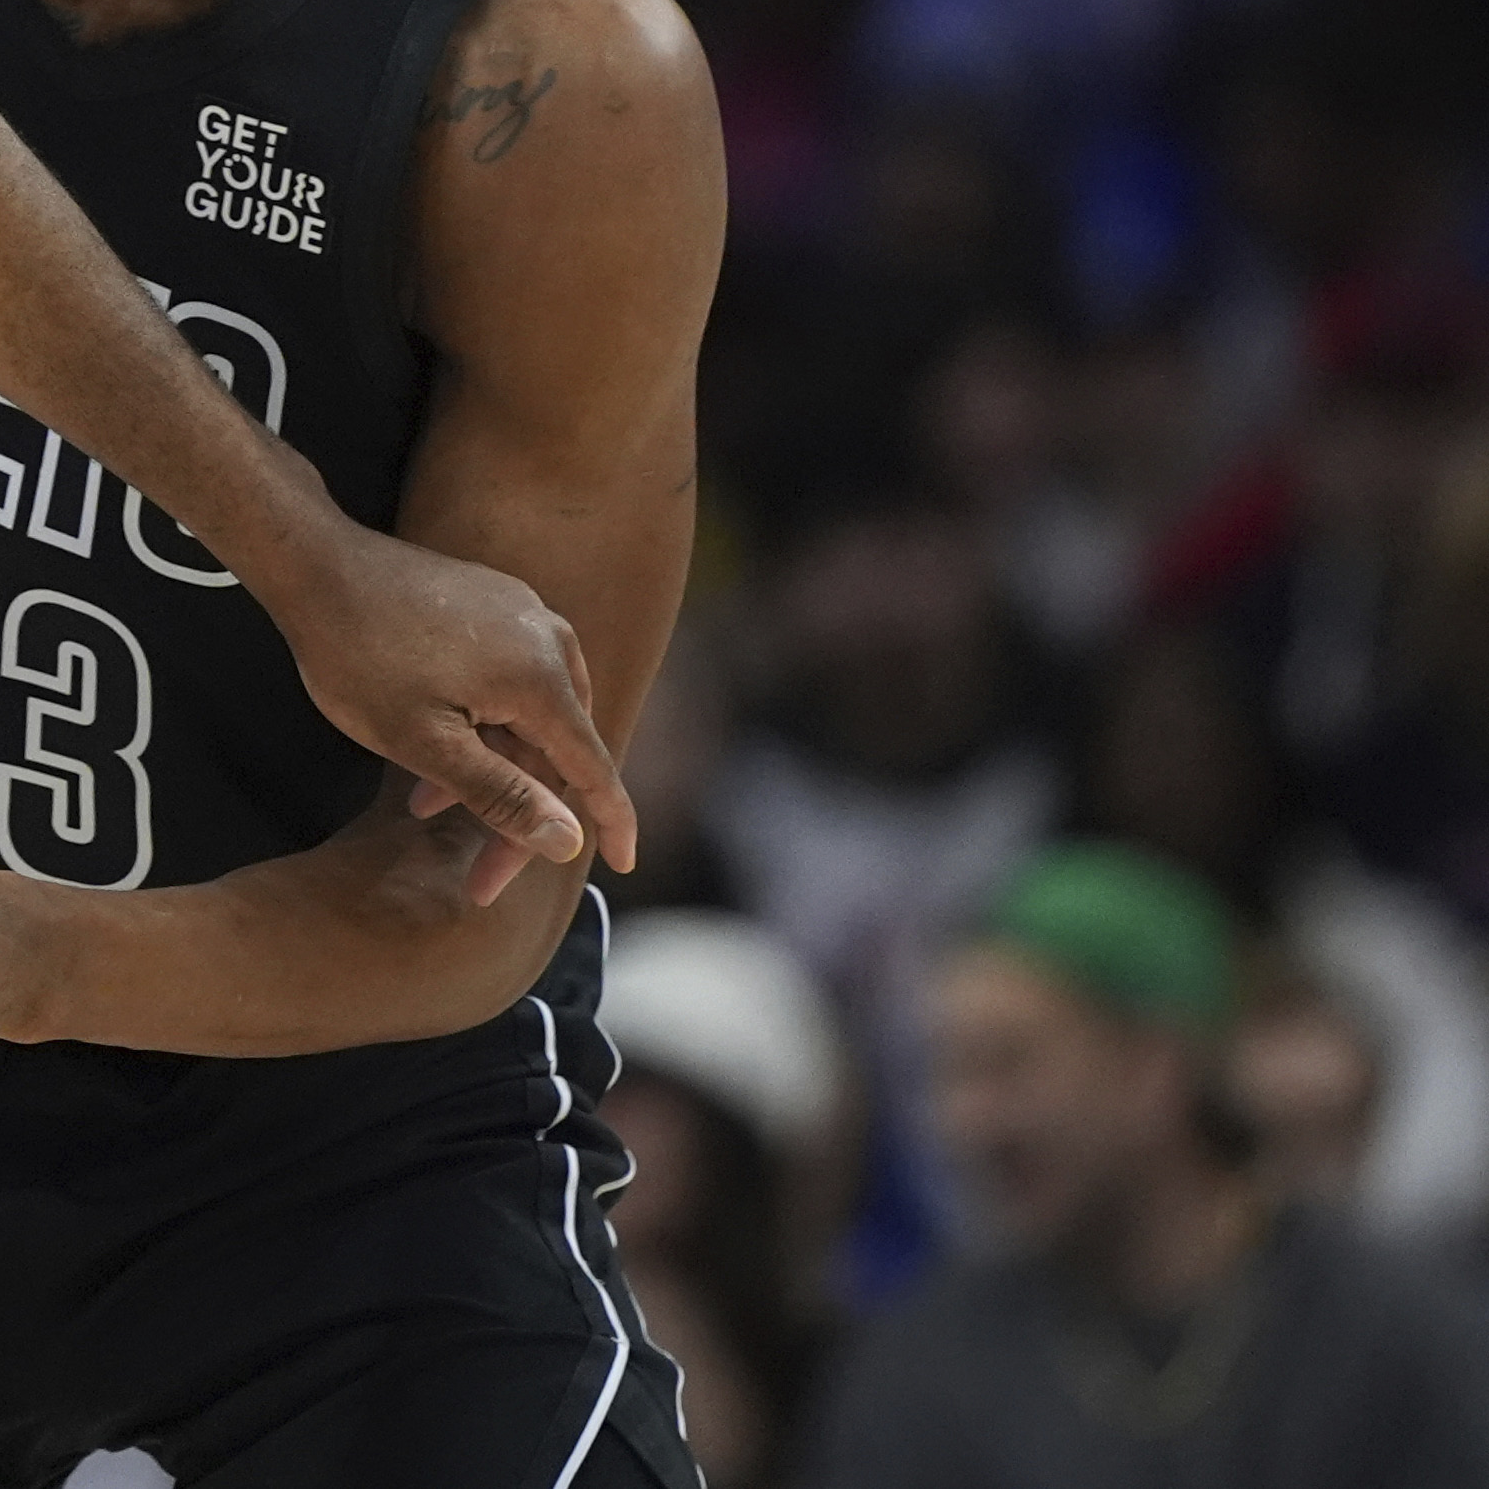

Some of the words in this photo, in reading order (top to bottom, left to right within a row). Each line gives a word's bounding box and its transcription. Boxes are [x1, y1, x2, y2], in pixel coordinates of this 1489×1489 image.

[197, 104, 289, 159] GET
[195, 140, 326, 214] YOUR
[184, 181, 327, 255] GUIDE
